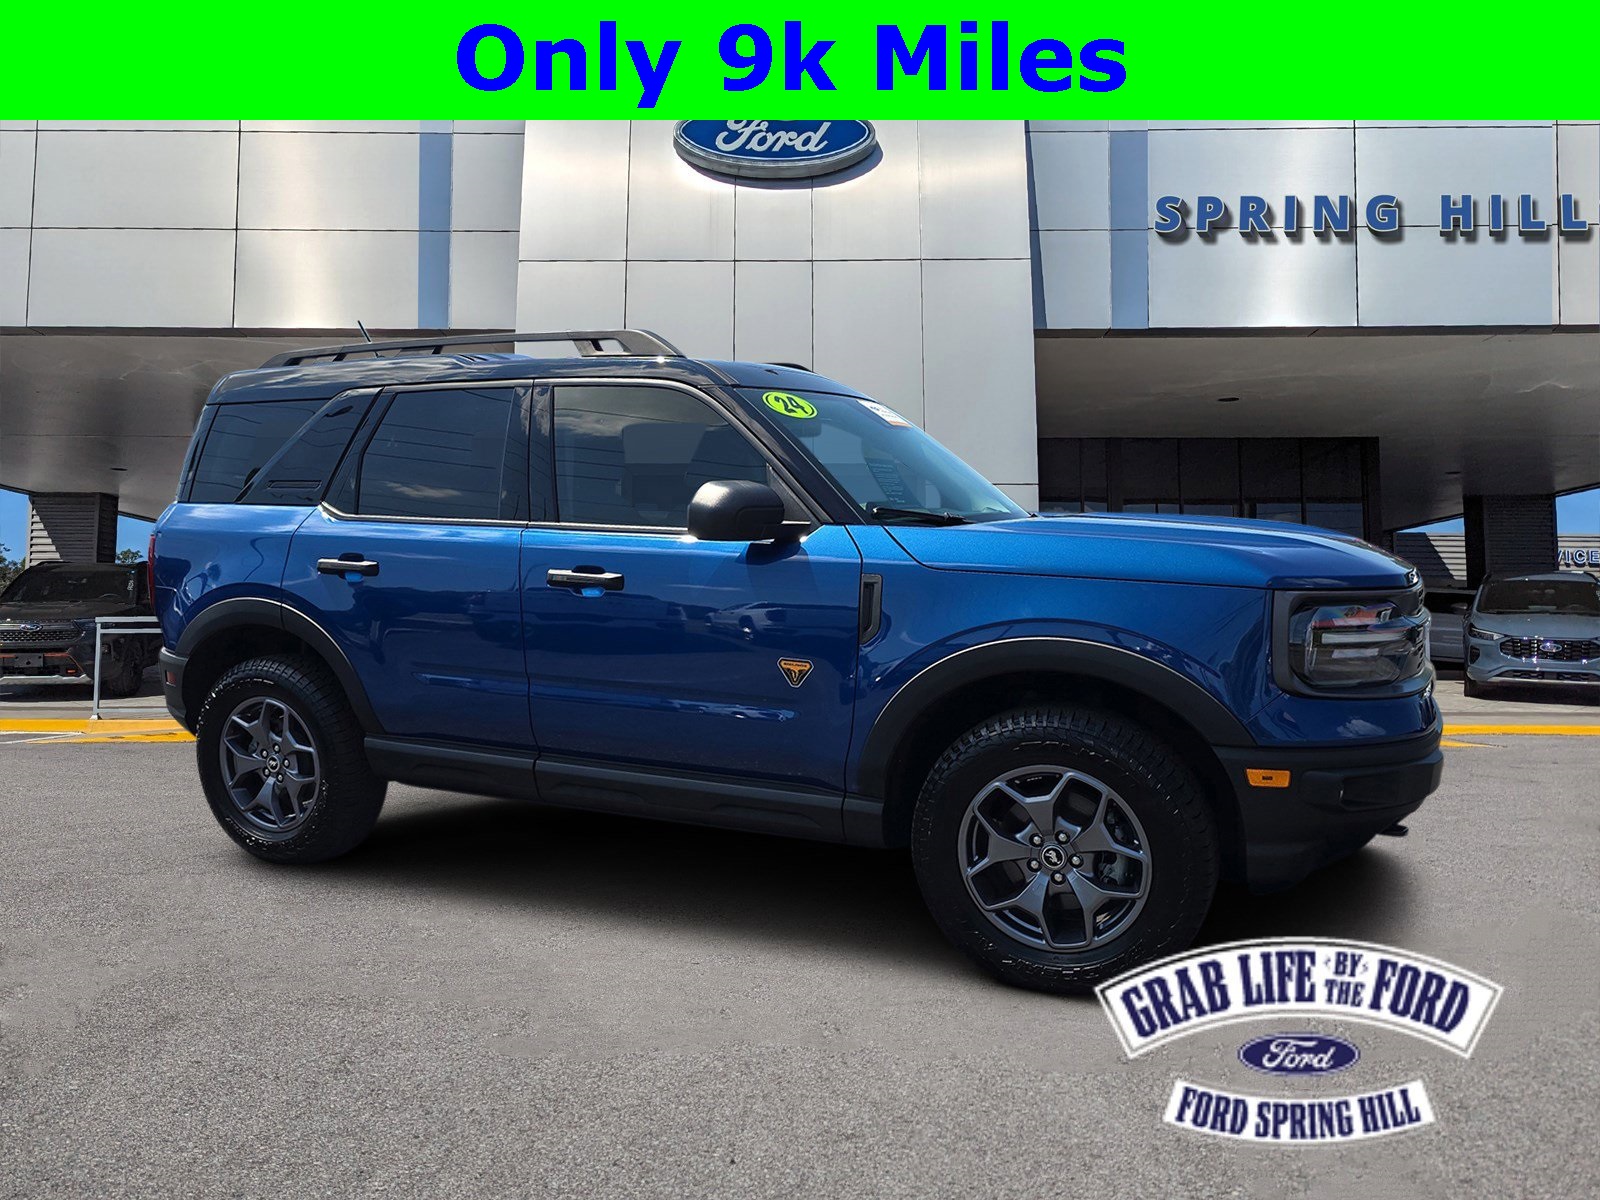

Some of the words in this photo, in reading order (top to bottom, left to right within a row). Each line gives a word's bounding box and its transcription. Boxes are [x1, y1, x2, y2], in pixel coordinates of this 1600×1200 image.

[716, 120, 831, 152] Ford
[1154, 194, 1399, 232] SPRING
[1440, 193, 1589, 231] HILL
[774, 396, 808, 414] 24
